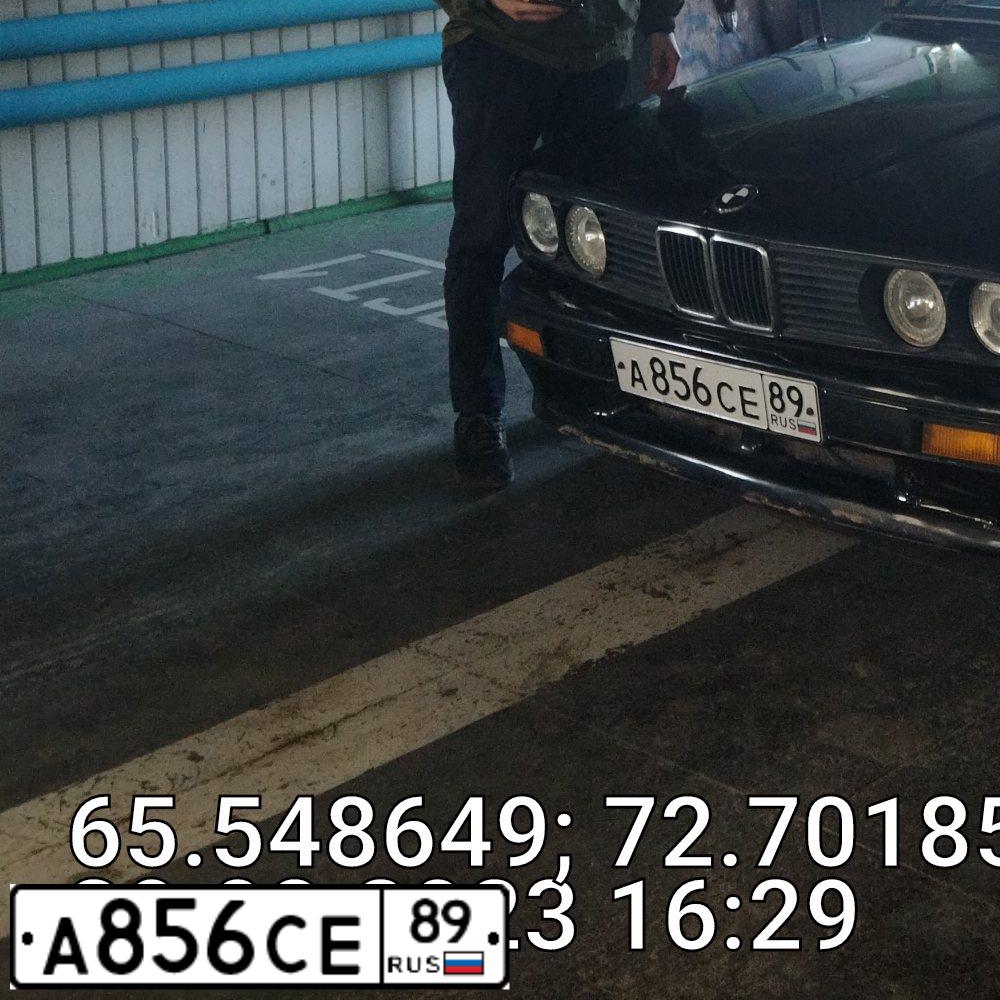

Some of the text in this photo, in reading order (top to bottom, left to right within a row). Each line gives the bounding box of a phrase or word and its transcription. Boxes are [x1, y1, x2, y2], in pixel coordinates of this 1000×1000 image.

[630, 356, 803, 420] А856СЕ 89
[770, 414, 797, 431] RUS
